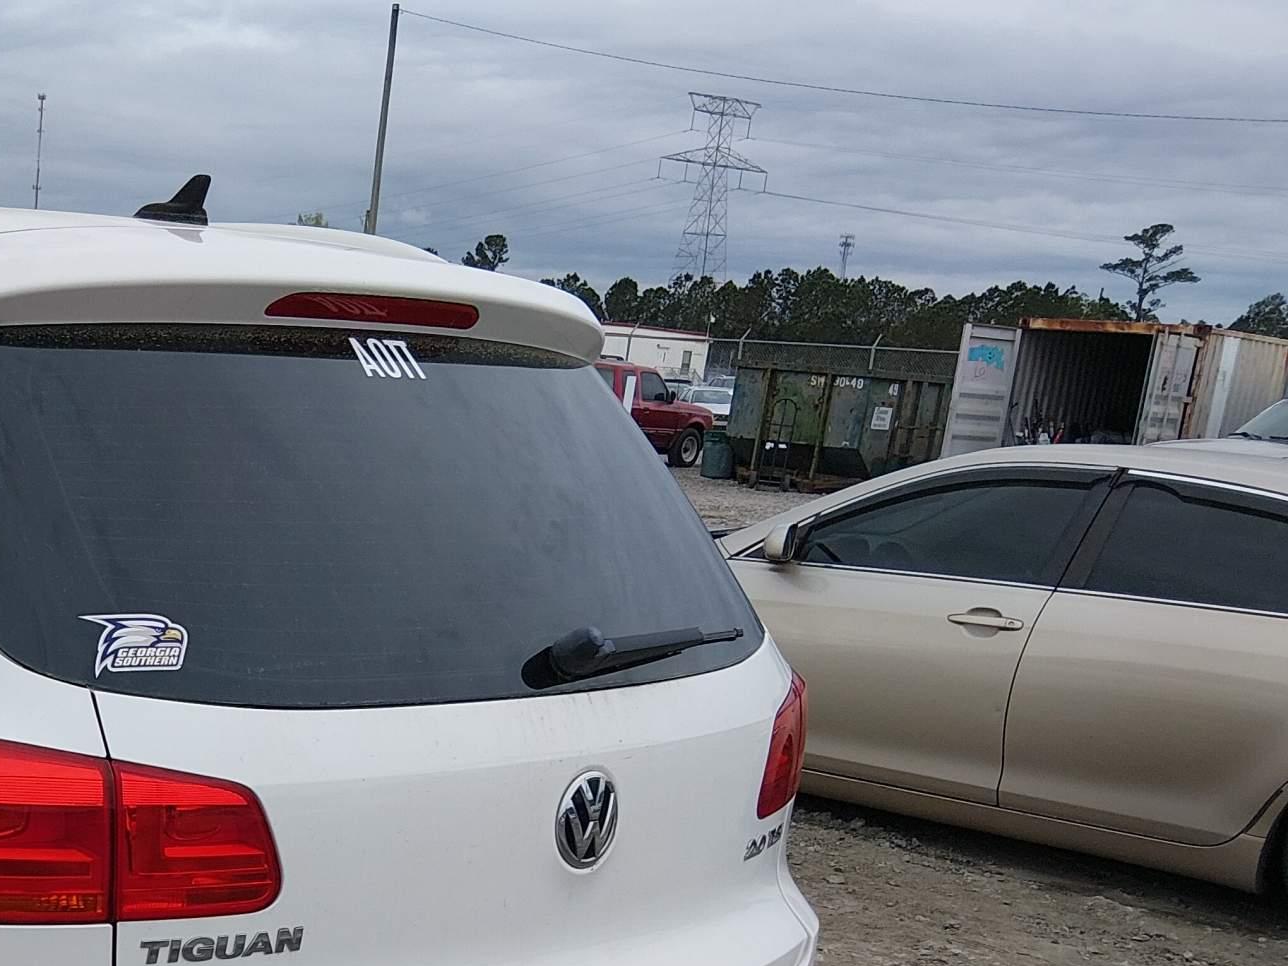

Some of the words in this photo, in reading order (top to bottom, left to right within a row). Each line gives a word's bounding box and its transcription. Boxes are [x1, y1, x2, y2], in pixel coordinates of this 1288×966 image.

[117, 647, 180, 658] GEORGIA
[114, 656, 178, 667] SOUTHERN
[139, 926, 304, 965] TIGUAN
